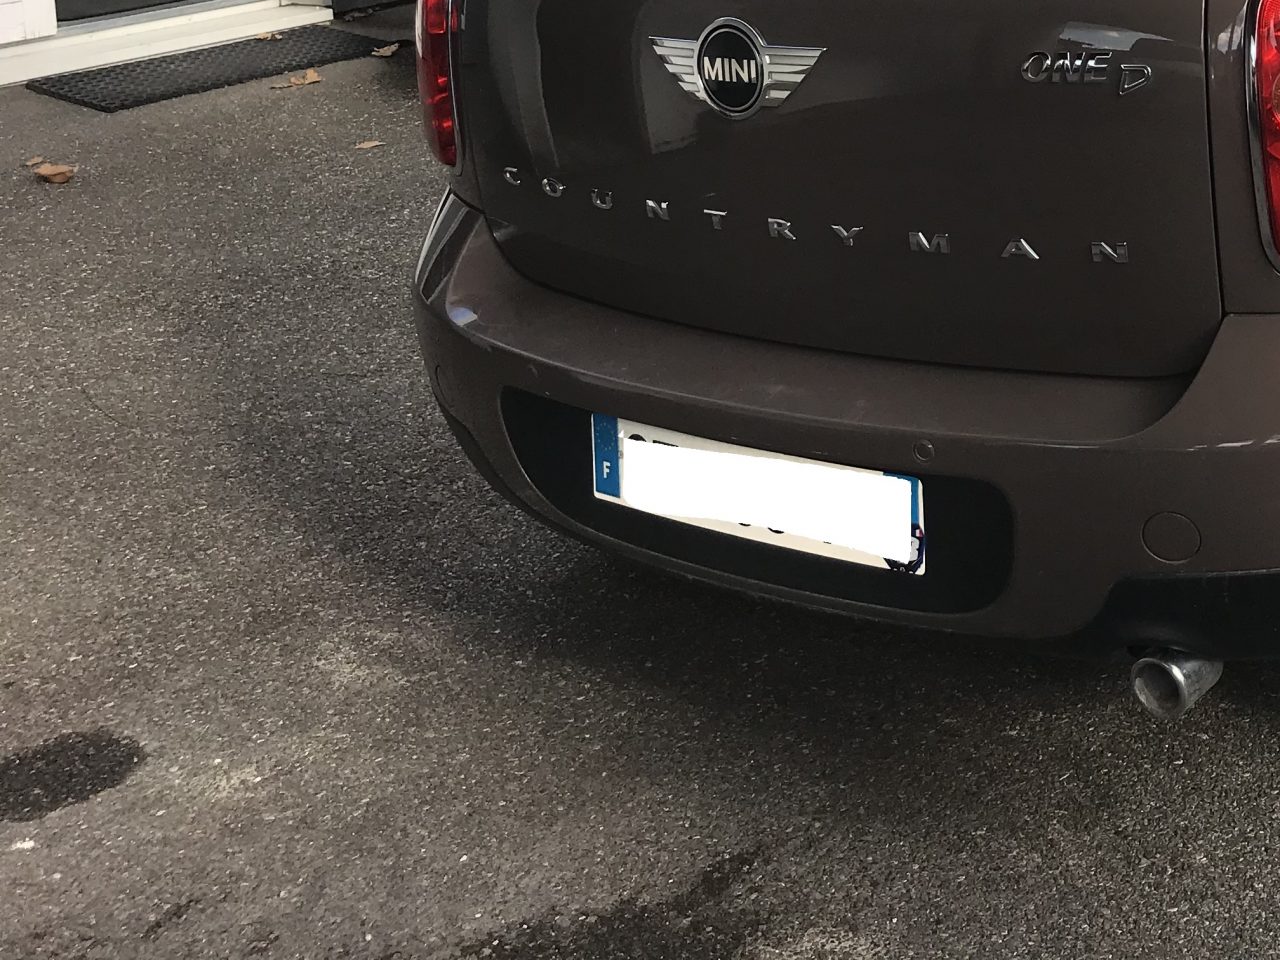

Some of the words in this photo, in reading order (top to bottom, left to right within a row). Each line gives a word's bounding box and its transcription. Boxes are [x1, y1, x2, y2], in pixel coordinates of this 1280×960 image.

[702, 56, 758, 84] MINI
[1021, 50, 1113, 83] ONE
[1119, 64, 1152, 95] D
[503, 166, 1129, 264] COUNTRYMAN
[602, 461, 611, 479] F
